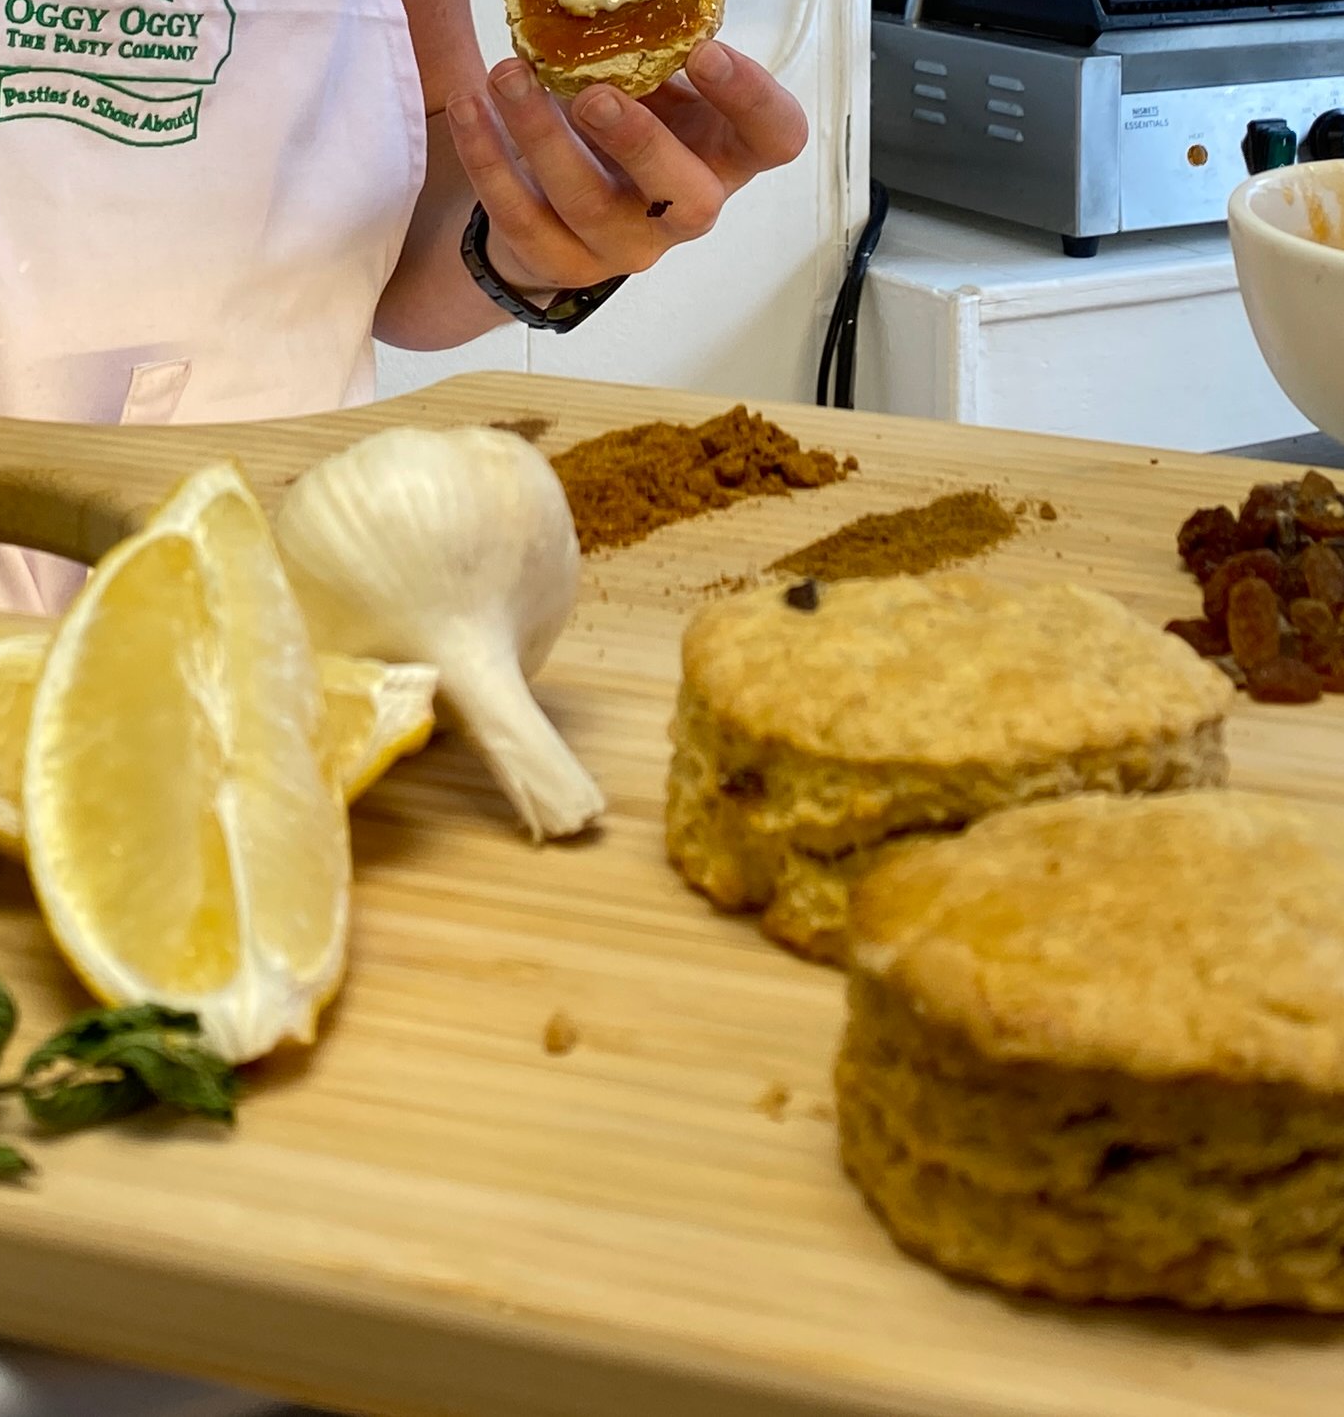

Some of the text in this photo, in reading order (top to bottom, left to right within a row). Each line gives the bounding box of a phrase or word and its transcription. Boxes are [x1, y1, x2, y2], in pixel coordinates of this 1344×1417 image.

[119, 6, 205, 39] OGGY
[6, 28, 198, 62] THE PASTY COMPANY
[3, 86, 71, 107] Pasties
[72, 90, 90, 108] to
[91, 97, 140, 129] Shout
